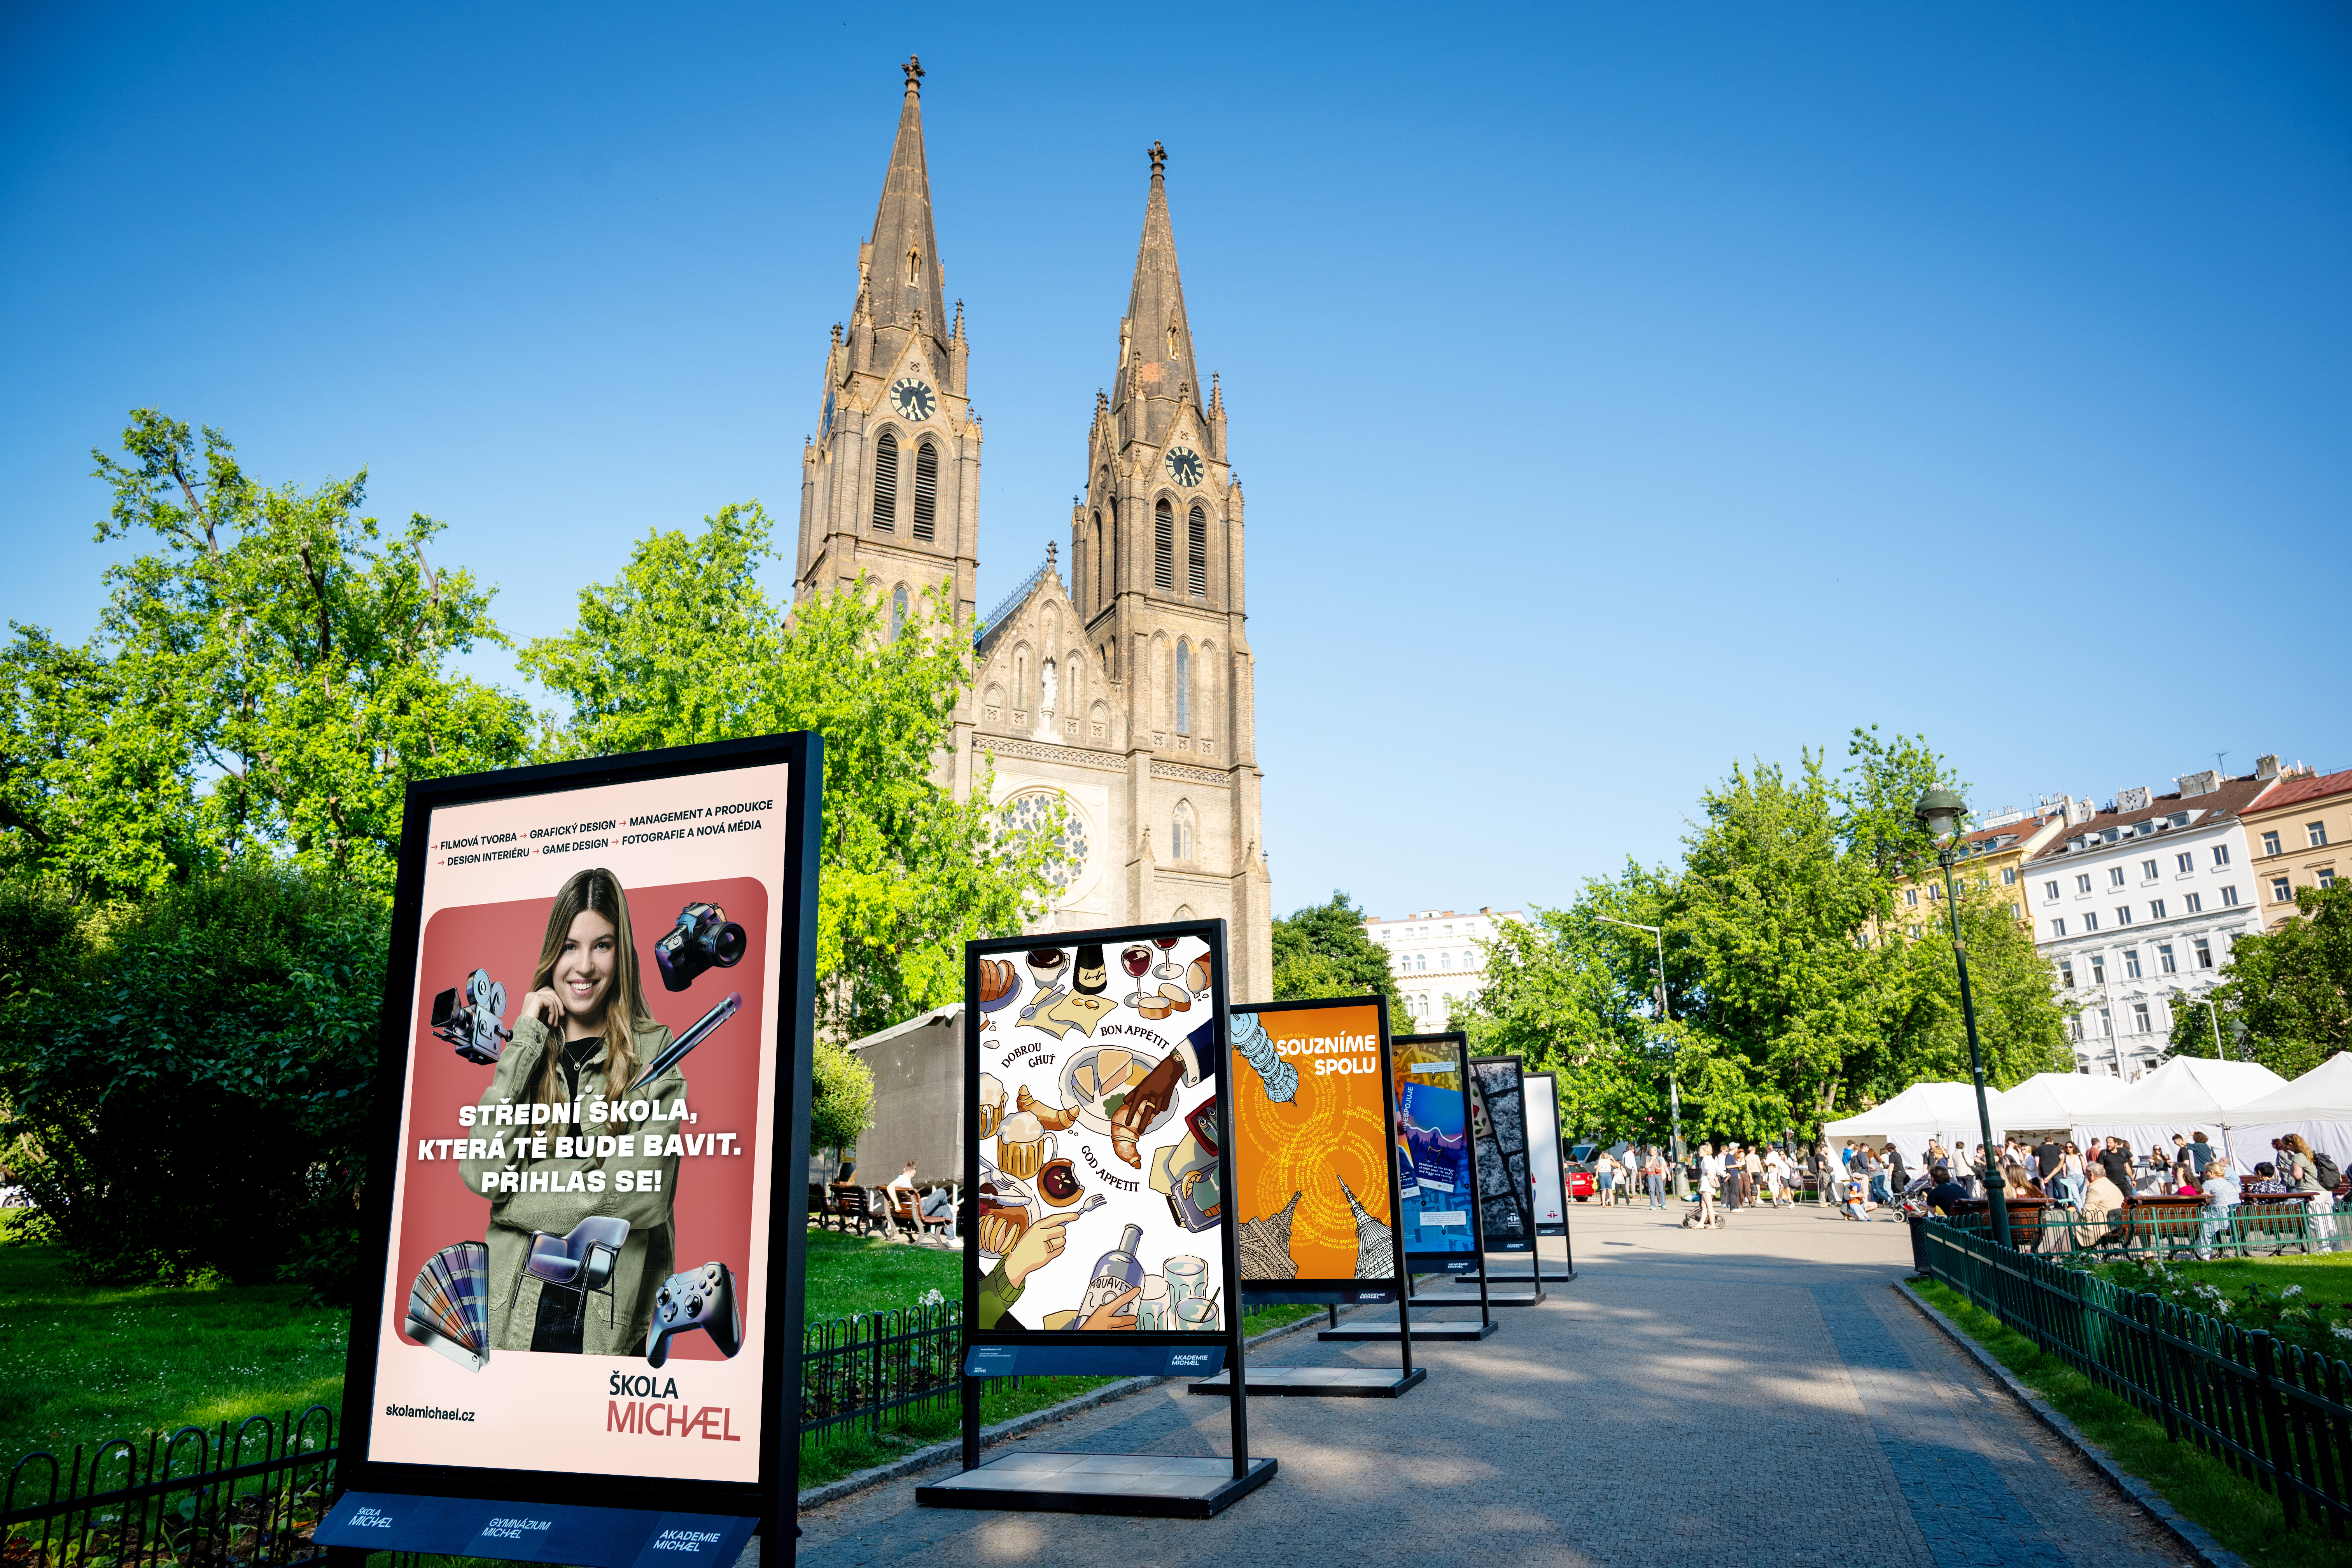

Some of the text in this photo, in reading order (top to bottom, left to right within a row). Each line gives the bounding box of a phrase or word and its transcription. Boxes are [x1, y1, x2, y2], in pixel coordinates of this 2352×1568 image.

[441, 800, 773, 850] FILMOVÁ TVORBA GRAFICKÝ DESIGN MANAGEMENT A PRODUKCE
[447, 819, 762, 866] DESIGN INTERIÉRU GAME DESIGN FOTOGRAFIE A NOVÁ MÉDIA
[1101, 1025, 1169, 1050] BON APPÉTIT
[1276, 1031, 1376, 1056] SOUZNÍME
[1001, 1043, 1041, 1069] DOBROU
[1028, 1054, 1055, 1068] CHUŤ
[1242, 1066, 1251, 1083] videre
[1315, 1057, 1376, 1076] SPOLU
[1304, 1074, 1312, 1082] det
[1311, 1082, 1320, 1096] stille
[1306, 1067, 1325, 1094] mennesker
[459, 1095, 697, 1126] STŘEDNÍ ŠKOLA,
[1356, 1106, 1372, 1116] Naplň
[1259, 1119, 1270, 1134] dette:
[1279, 1120, 1295, 1129] norske
[1303, 1122, 1318, 1134] tidene
[1308, 1126, 1322, 1139] bærer
[1320, 1126, 1329, 1134] lys.
[1361, 1115, 1385, 1134] krok vpřed
[1248, 1132, 1258, 1144] etter
[1270, 1134, 1278, 1143] vite
[1321, 1131, 1334, 1141] chvil.
[418, 1131, 741, 1160] KTERÁ TĚ BUDE BAVIT.
[1263, 1158, 1271, 1166] les
[1347, 1146, 1365, 1165] jemném
[1082, 1146, 1140, 1192] GOD APPETIT
[1348, 1131, 1361, 1140] slova
[1361, 1138, 1376, 1154] nejsou
[1374, 1190, 1382, 1202] jsou
[481, 1166, 662, 1192] PŘIHLAS SE!
[1256, 1167, 1265, 1184] jours
[1258, 1197, 1267, 1218] même
[1302, 1202, 1312, 1214] máš
[1320, 1241, 1347, 1250] sám/sama
[1089, 1278, 1131, 1292] AQUAVIT
[609, 1370, 679, 1399] ŠKOLA
[386, 1404, 475, 1422] skolamichael.cz
[357, 1507, 381, 1516] ŠKOLA
[489, 1518, 551, 1530] GYMNÁZIUM
[659, 1530, 721, 1542] AKADEMIE
